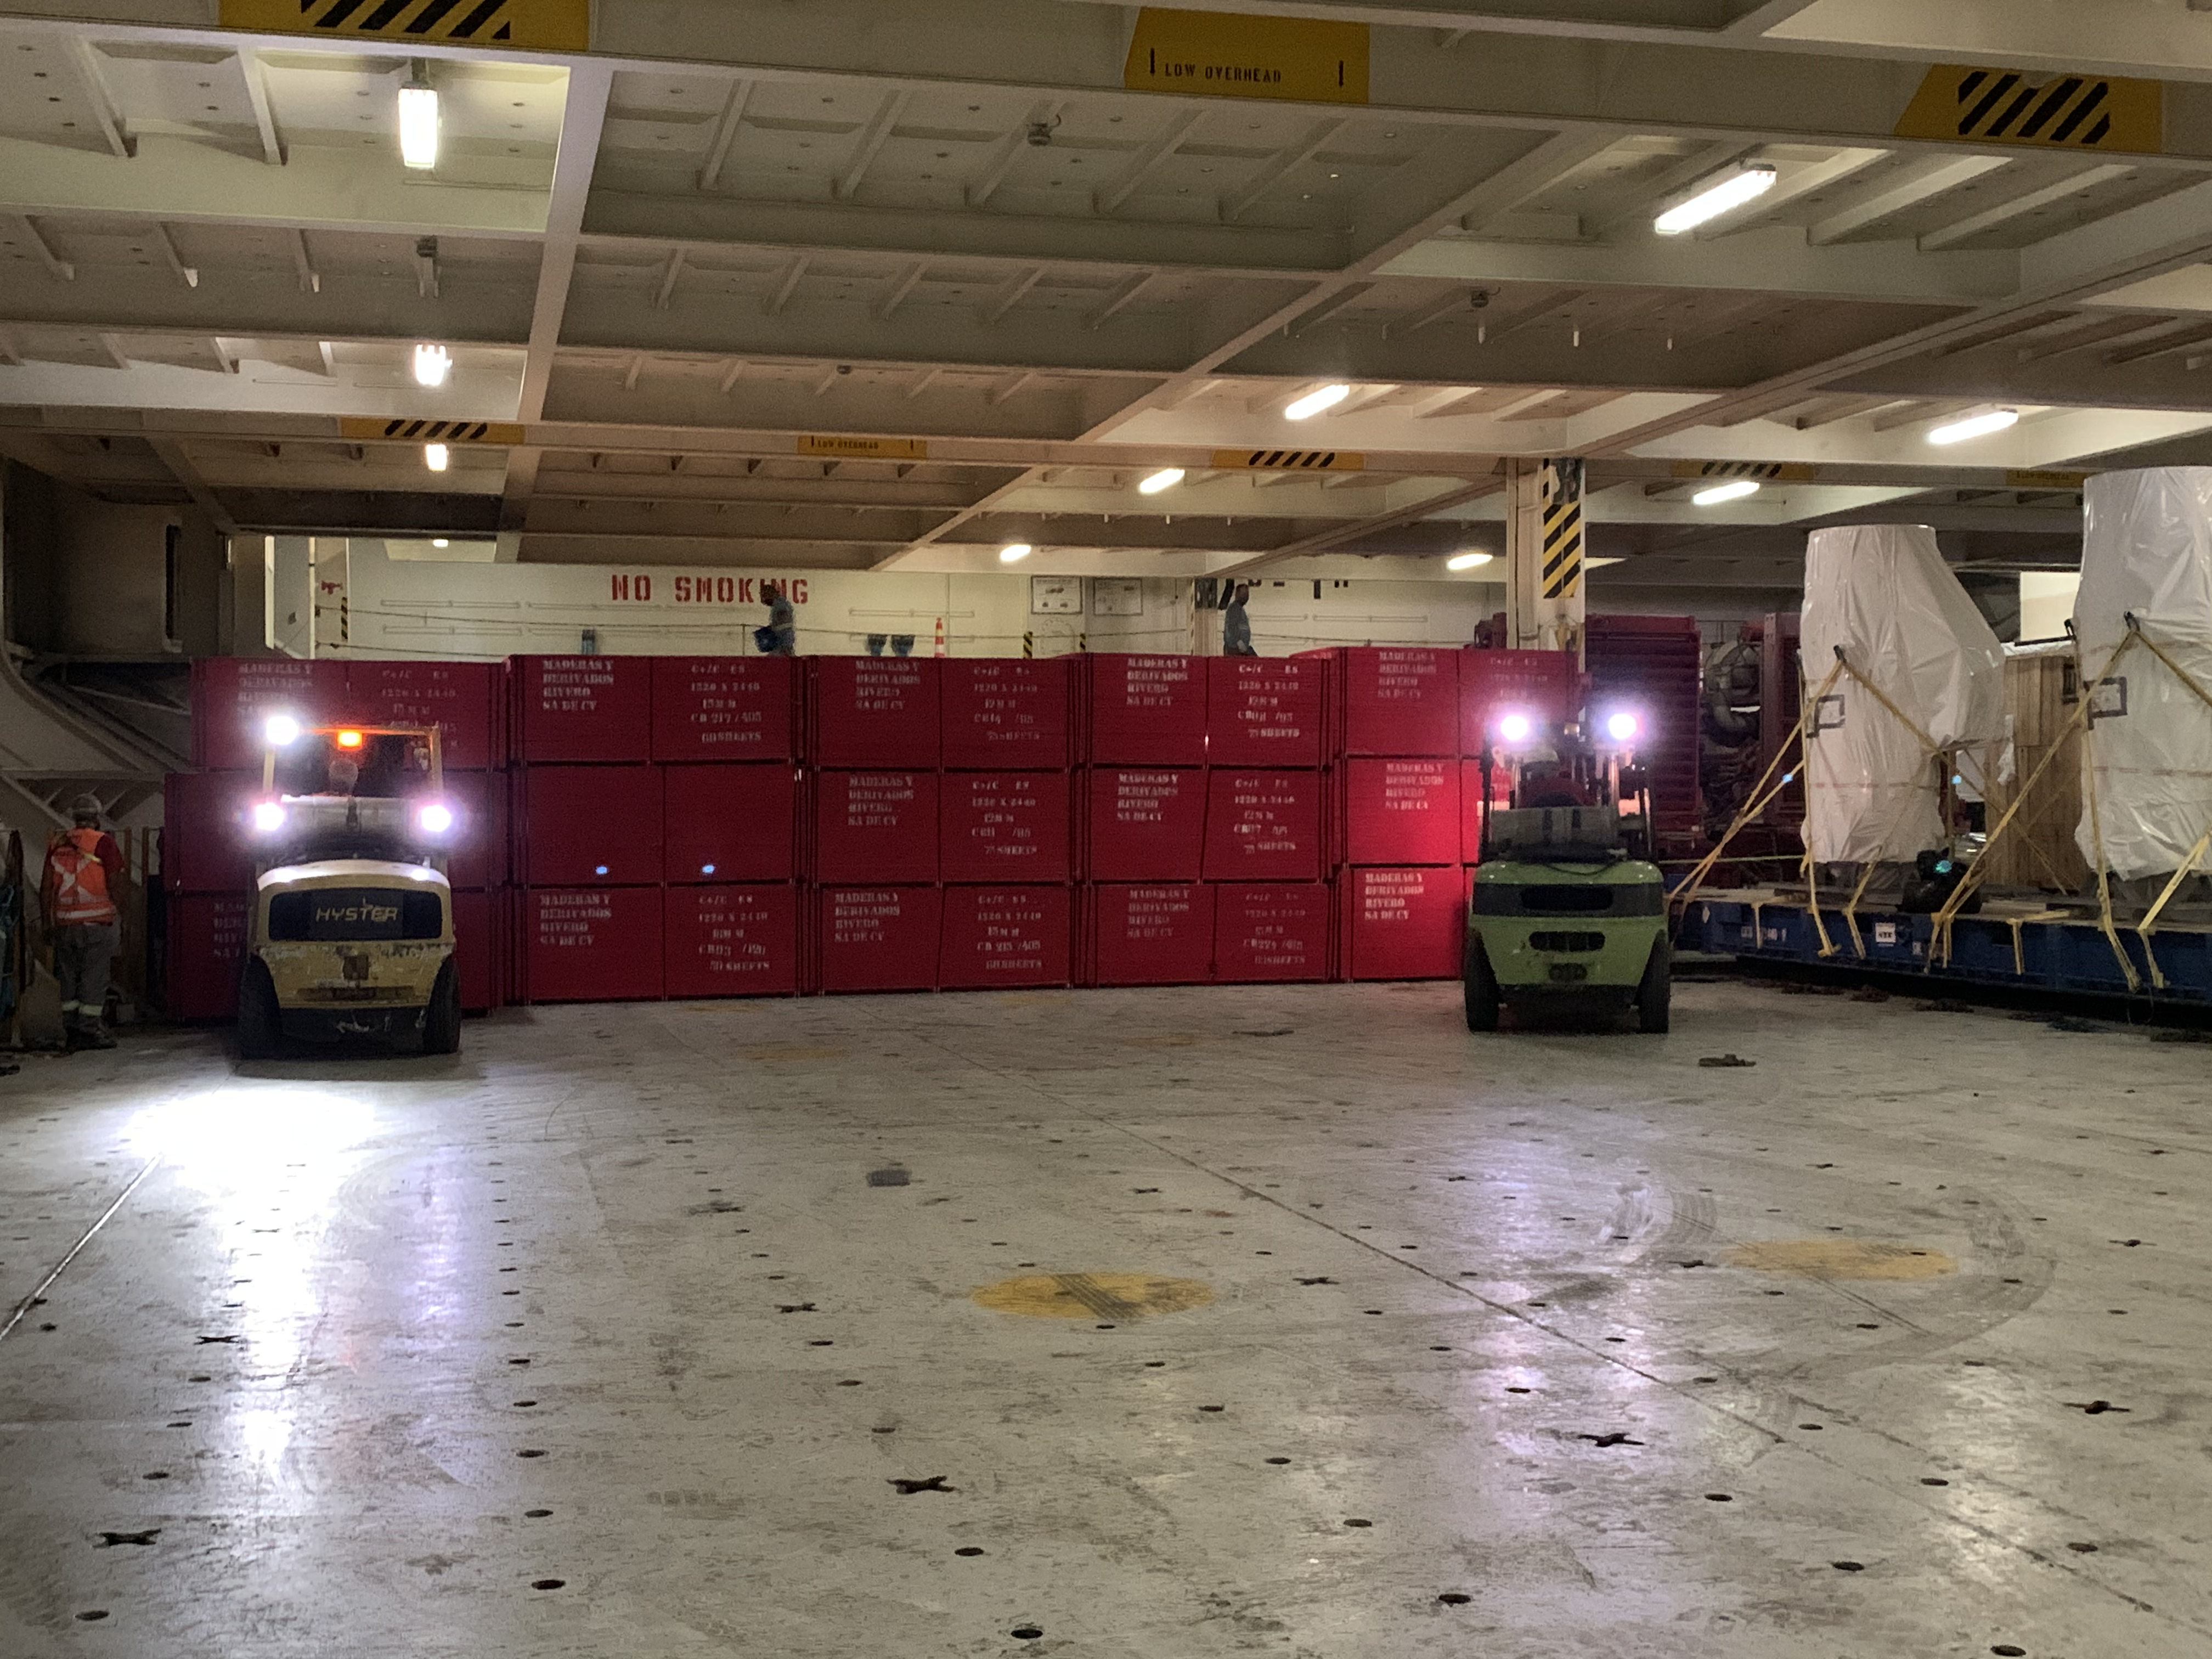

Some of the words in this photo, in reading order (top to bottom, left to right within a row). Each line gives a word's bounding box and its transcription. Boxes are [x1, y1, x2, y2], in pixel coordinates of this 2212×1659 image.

[1165, 63, 1195, 77] LOW
[1205, 66, 1281, 82] OVERHEAD
[612, 574, 651, 601] NO
[315, 906, 398, 922] HYSTER
